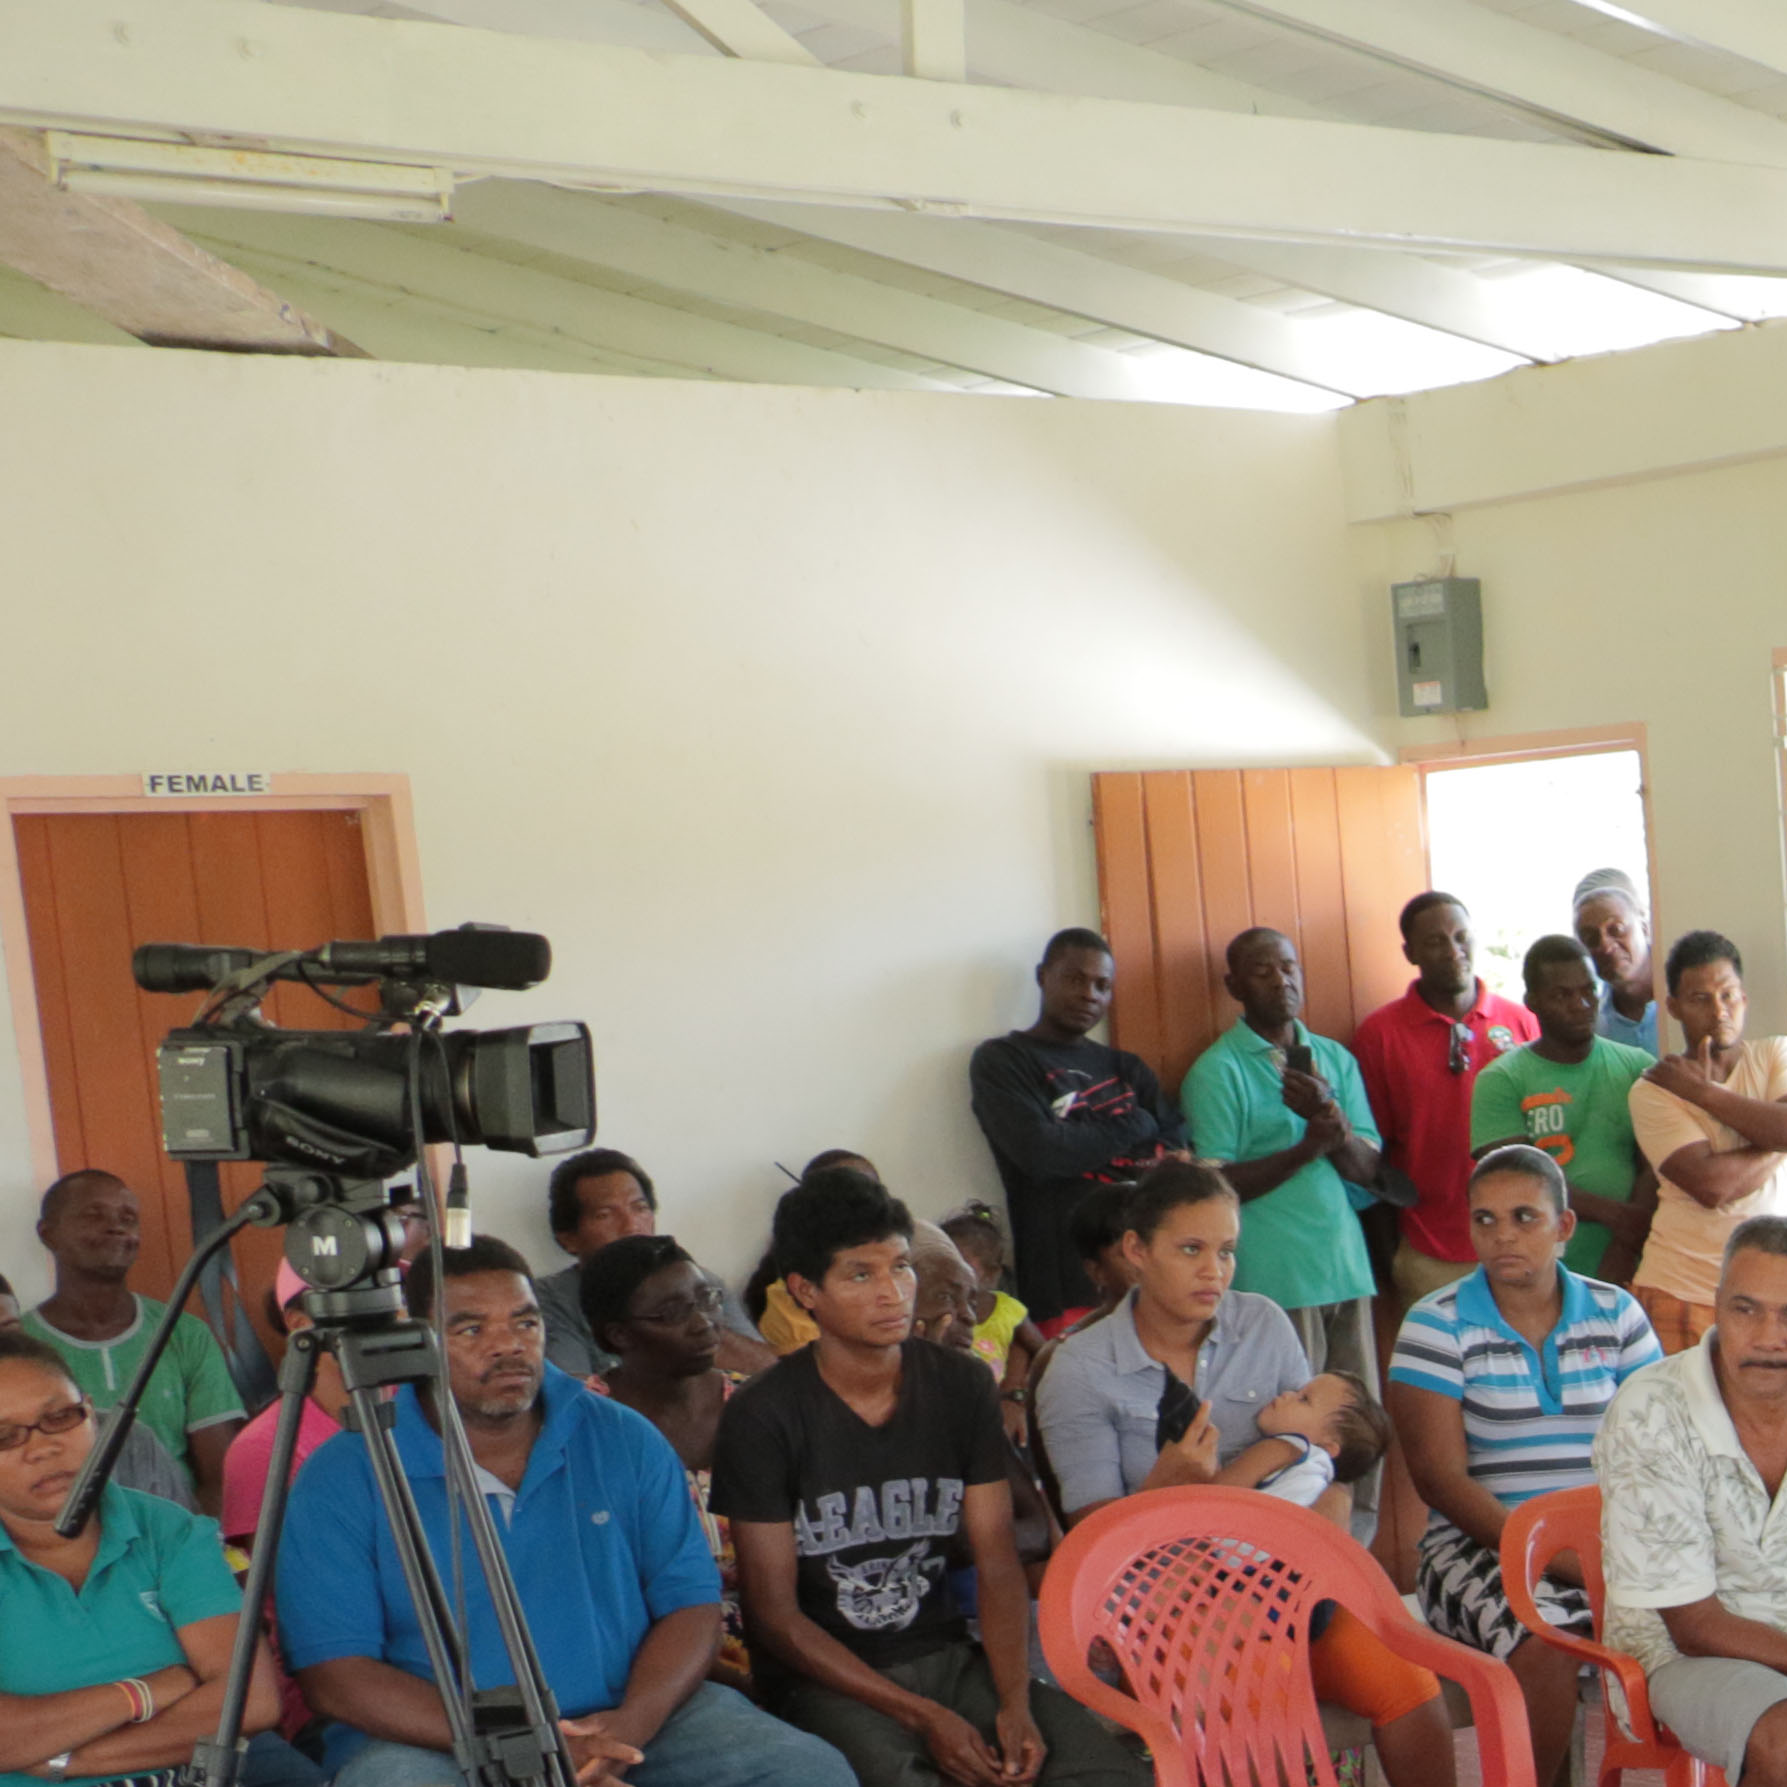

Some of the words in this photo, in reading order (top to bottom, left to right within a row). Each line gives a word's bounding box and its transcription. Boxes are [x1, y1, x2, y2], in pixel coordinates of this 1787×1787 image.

[149, 773, 264, 793] FEMALE
[286, 1135, 346, 1165] SONY
[312, 1235, 337, 1256] M
